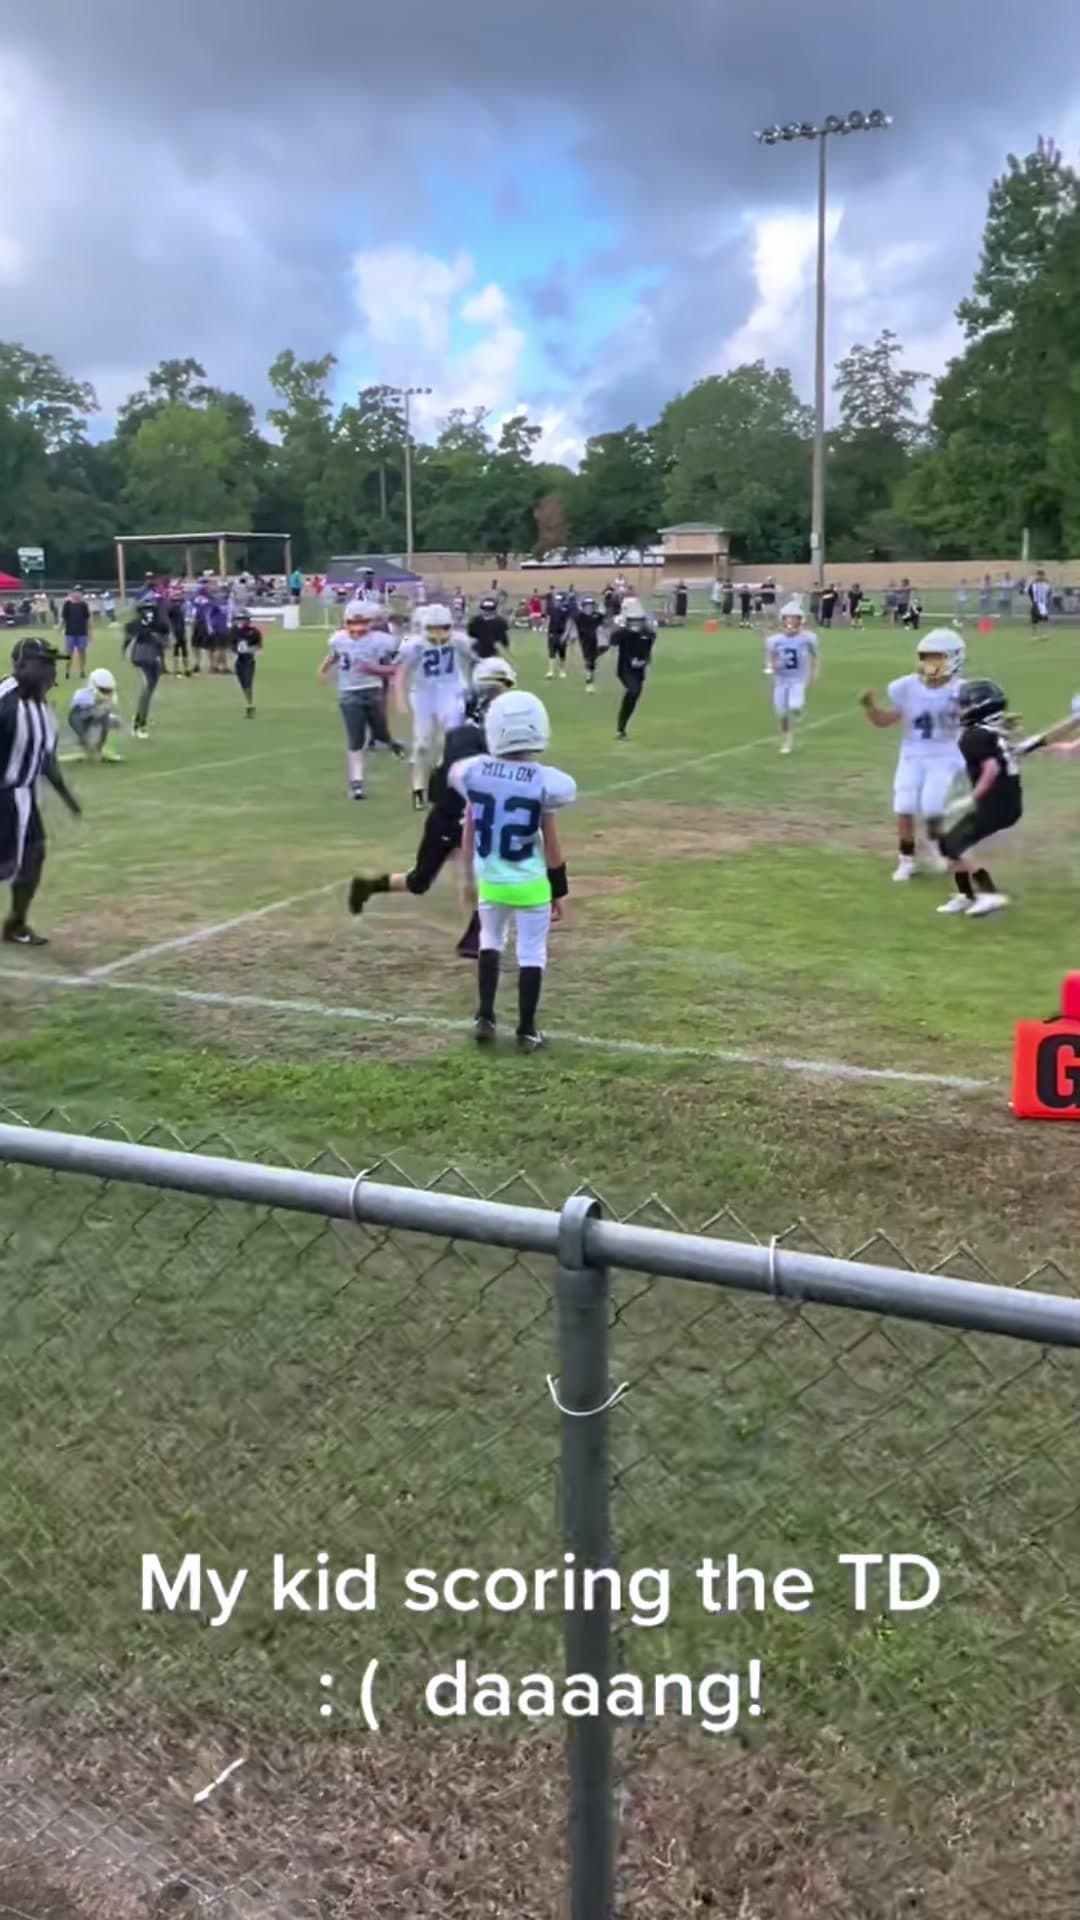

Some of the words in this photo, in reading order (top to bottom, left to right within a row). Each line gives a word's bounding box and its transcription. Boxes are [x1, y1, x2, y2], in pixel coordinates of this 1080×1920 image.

[423, 647, 455, 677] 27
[784, 648, 798, 669] 3
[1036, 1033, 1080, 1109] G
